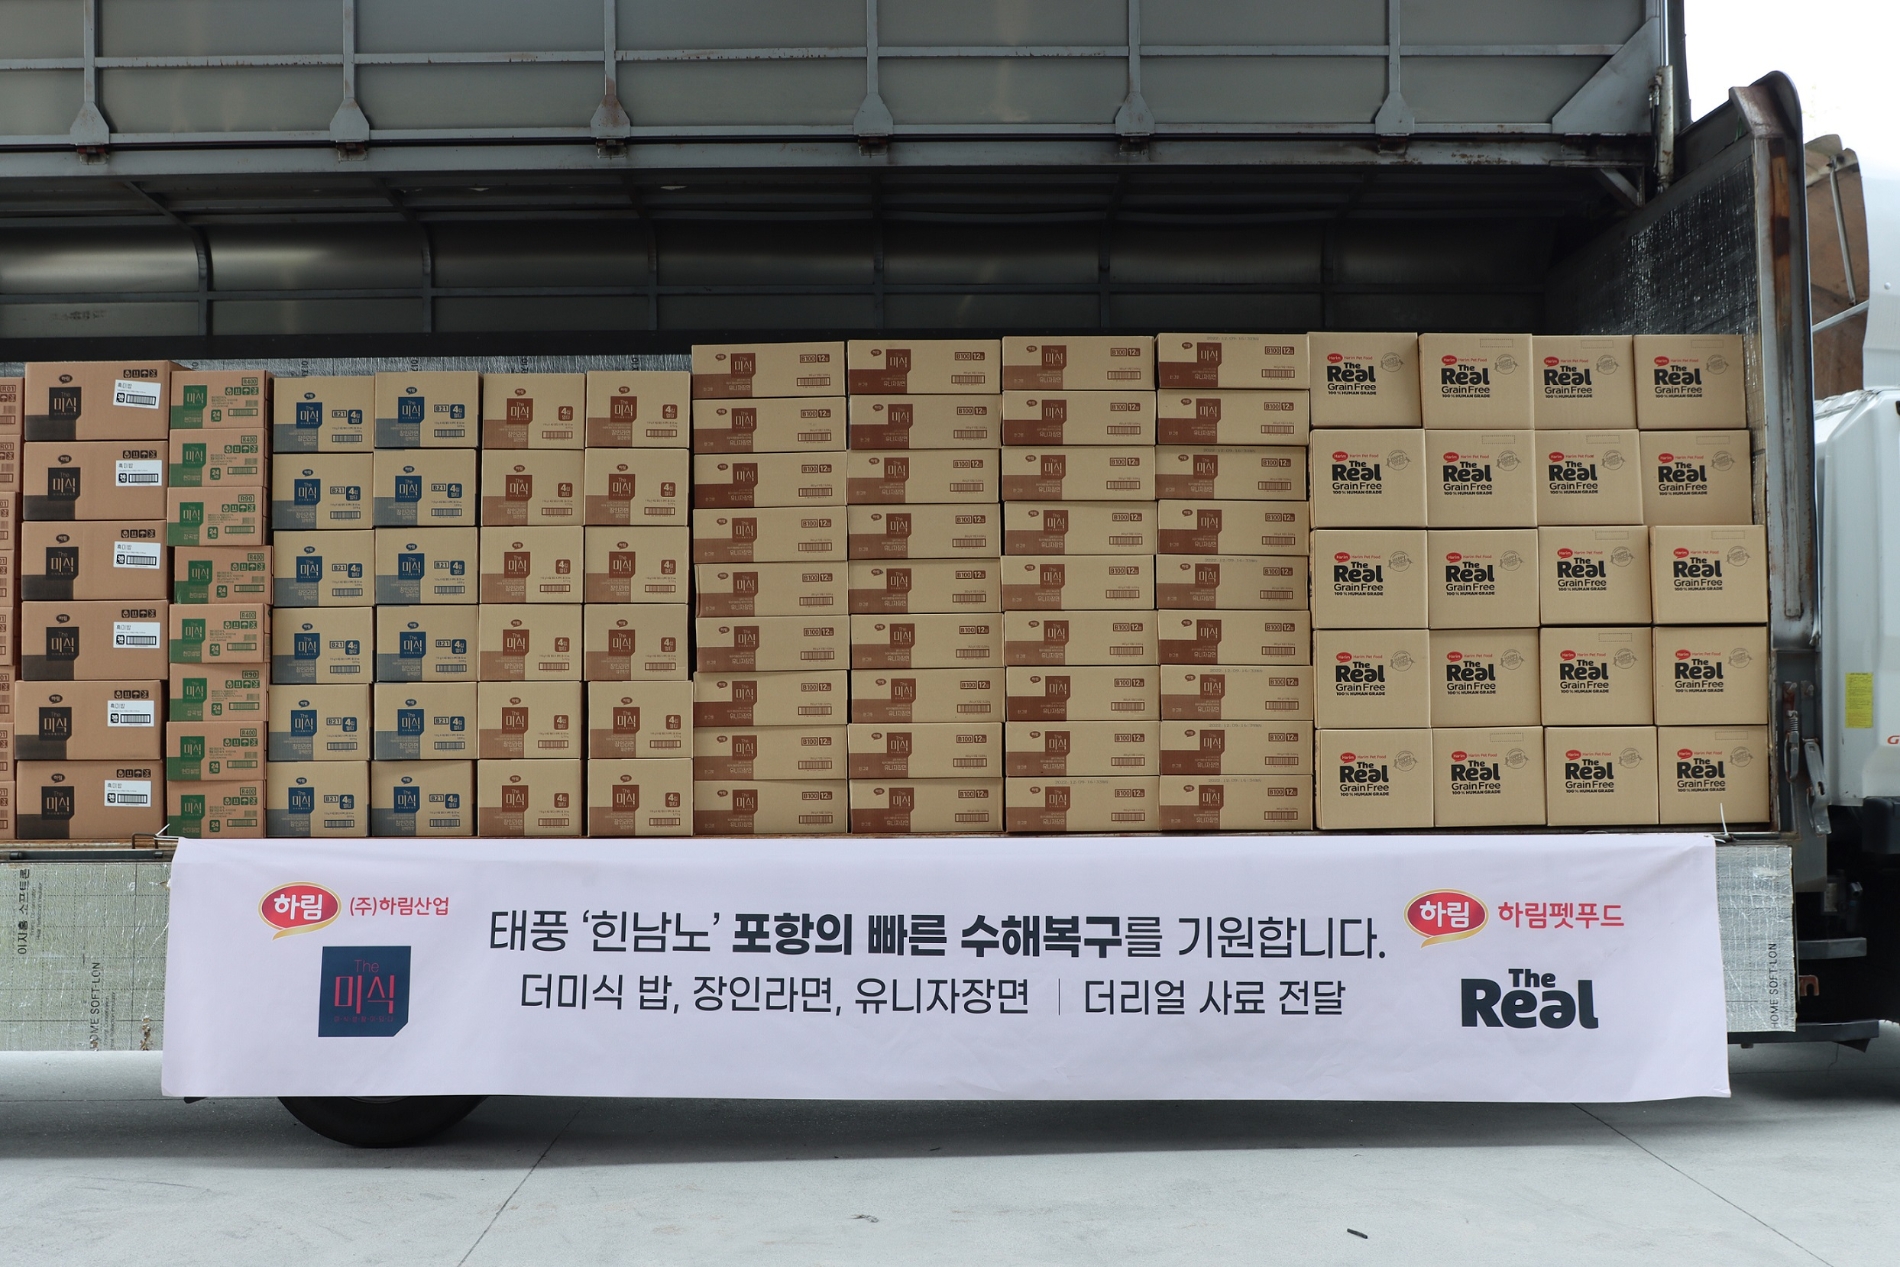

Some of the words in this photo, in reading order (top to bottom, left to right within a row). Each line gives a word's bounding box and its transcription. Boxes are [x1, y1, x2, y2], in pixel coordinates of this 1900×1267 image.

[734, 361, 752, 372] 미식
[1327, 365, 1376, 382] Real
[1441, 368, 1489, 385] Real
[1544, 369, 1592, 386] Real
[1654, 369, 1701, 385] Real
[54, 397, 76, 412] 미식
[510, 406, 529, 418] 미식
[301, 410, 318, 422] 미식
[892, 412, 909, 423] 미식
[186, 451, 202, 462] 미식
[1044, 462, 1062, 474] 미식
[1332, 464, 1381, 481] Real
[1443, 465, 1492, 482] Real
[1549, 464, 1597, 481] Real
[1658, 465, 1706, 482] Real
[53, 478, 75, 493] 미식
[400, 484, 417, 495] 미식
[612, 482, 631, 494] 미식
[183, 510, 200, 521] 미식
[1201, 517, 1218, 528] 미식
[51, 557, 73, 572] 미식
[301, 564, 318, 576] 미식
[612, 560, 632, 572] 미식
[1557, 561, 1606, 578] Real
[1674, 561, 1722, 577] Real
[1334, 565, 1383, 582] Real
[1446, 565, 1494, 582] Real
[185, 626, 202, 638] 미식
[52, 637, 74, 652] 미식
[299, 641, 316, 653] 미식
[506, 638, 526, 650] 미식
[1336, 665, 1385, 682] Real
[1447, 664, 1495, 681] Real
[1560, 663, 1608, 680] Real
[1675, 662, 1723, 679] Real
[44, 717, 66, 732] 미식
[402, 717, 420, 729] 미식
[506, 715, 524, 727] 미식
[1340, 765, 1388, 783] Real
[1451, 763, 1500, 781] Real
[1566, 763, 1613, 779] Real
[1677, 761, 1725, 778] Real
[47, 797, 69, 812] 미식
[398, 794, 416, 806] 미식
[616, 793, 635, 805] 미식
[1049, 794, 1067, 805] 미식
[184, 803, 201, 814] 미식
[19, 868, 30, 915] 소프트론
[274, 893, 323, 920] 하림
[350, 897, 449, 916] (주)하림산업
[1419, 900, 1470, 928] 하림
[1498, 902, 1625, 929] 하림펫푸드
[17, 920, 29, 955] 이지홈
[491, 909, 568, 952] 태풍
[733, 912, 853, 956] 포항의
[867, 914, 947, 957] 빠른
[961, 914, 1163, 959] 수해복구를
[1178, 916, 1386, 959] 기원합니다.
[354, 959, 380, 973] The
[1508, 968, 1556, 989] The
[89, 961, 101, 1016] SOFT-LON
[334, 974, 395, 1014] 미식
[522, 973, 623, 1010] 더미식
[639, 974, 679, 1014] 밥,
[693, 975, 842, 1017] 장인라면,
[855, 977, 1029, 1015] 유니자장면
[1085, 979, 1185, 1016] 더리얼
[1199, 980, 1266, 1016] 사료
[1279, 980, 1346, 1015] 전달
[1461, 978, 1599, 1029] Real
[1770, 998, 1779, 1028] HOME
